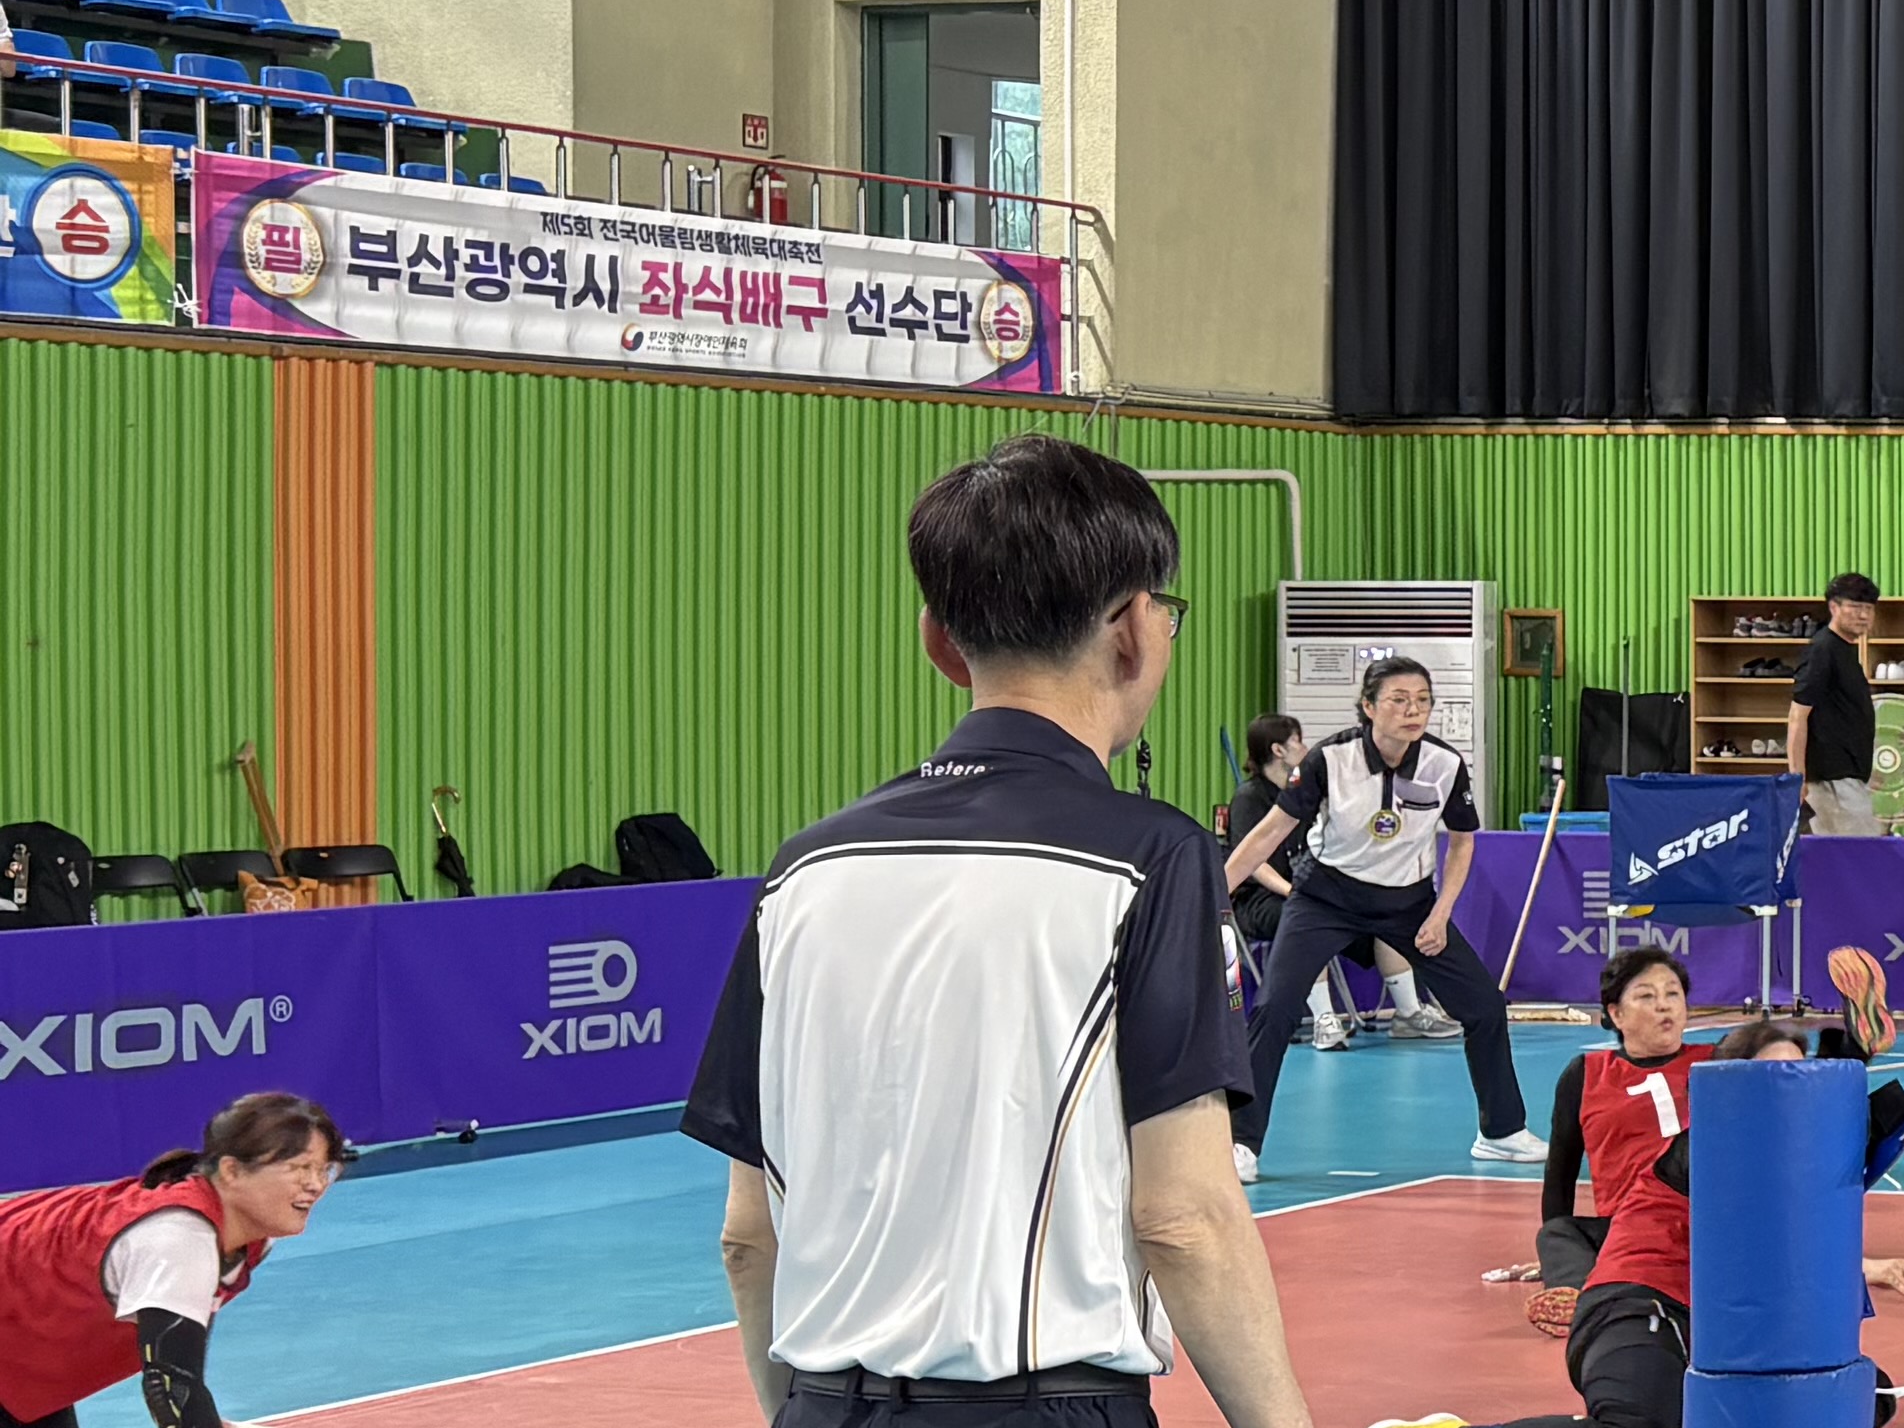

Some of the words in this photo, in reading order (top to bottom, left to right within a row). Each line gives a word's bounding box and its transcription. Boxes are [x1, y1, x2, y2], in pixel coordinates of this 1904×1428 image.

[55, 199, 110, 255] 승
[261, 223, 303, 274] 필
[539, 212, 594, 240] 제5회
[600, 219, 823, 265] 전국어울림생활체육대축전
[347, 225, 619, 314] 부산광역시
[639, 260, 829, 332] 좌식배구
[845, 281, 972, 343] 선수단
[993, 302, 1022, 342] 승
[521, 1008, 662, 1060] XIOM
[1626, 1072, 1681, 1138] 1
